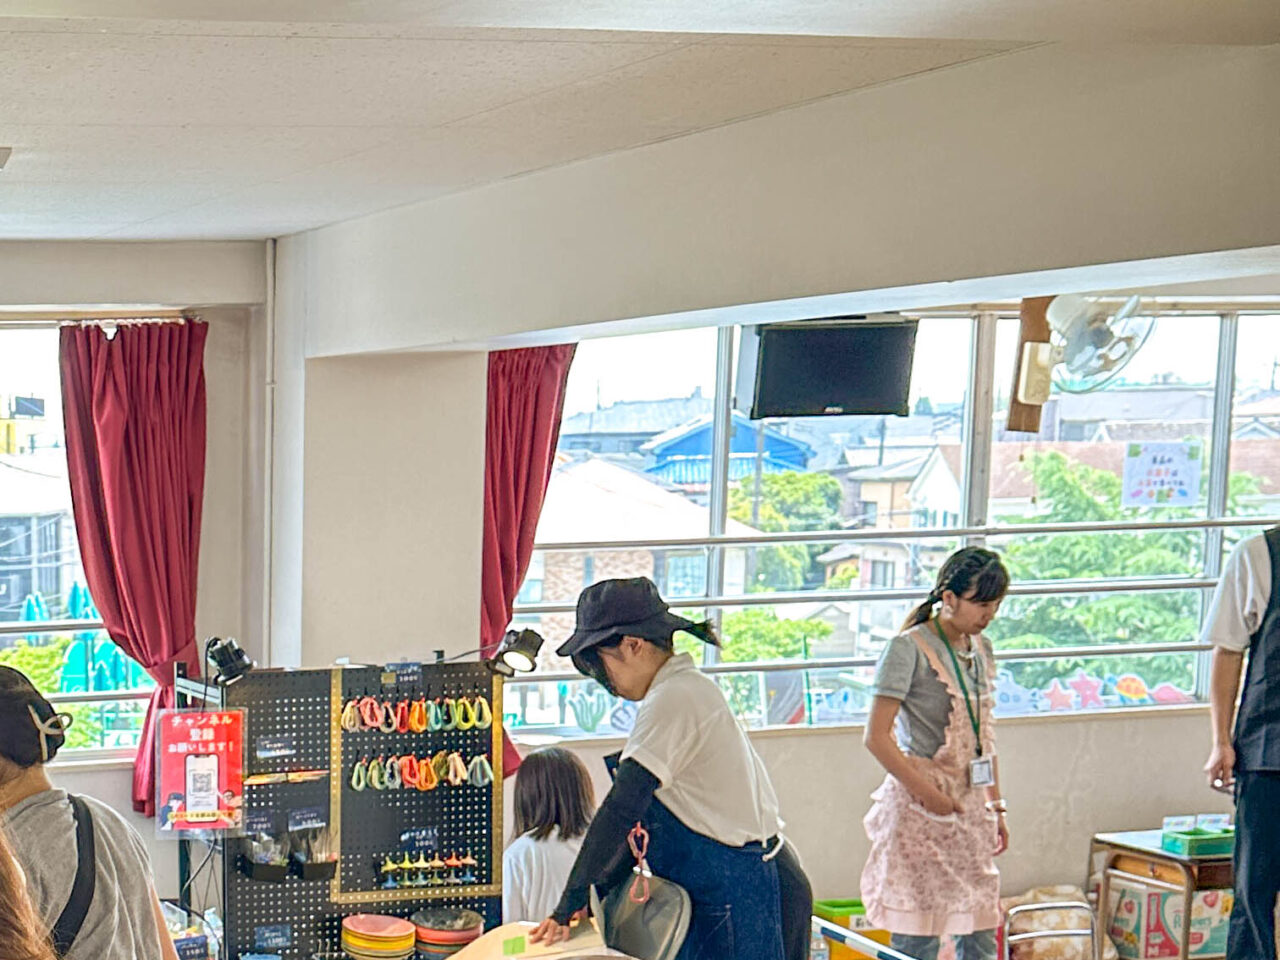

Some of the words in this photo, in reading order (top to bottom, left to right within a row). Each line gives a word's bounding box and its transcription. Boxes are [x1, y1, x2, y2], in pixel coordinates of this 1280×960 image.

[171, 715, 233, 727] チャンネル
[190, 728, 215, 741] 登録
[168, 741, 235, 753] お願いします！
